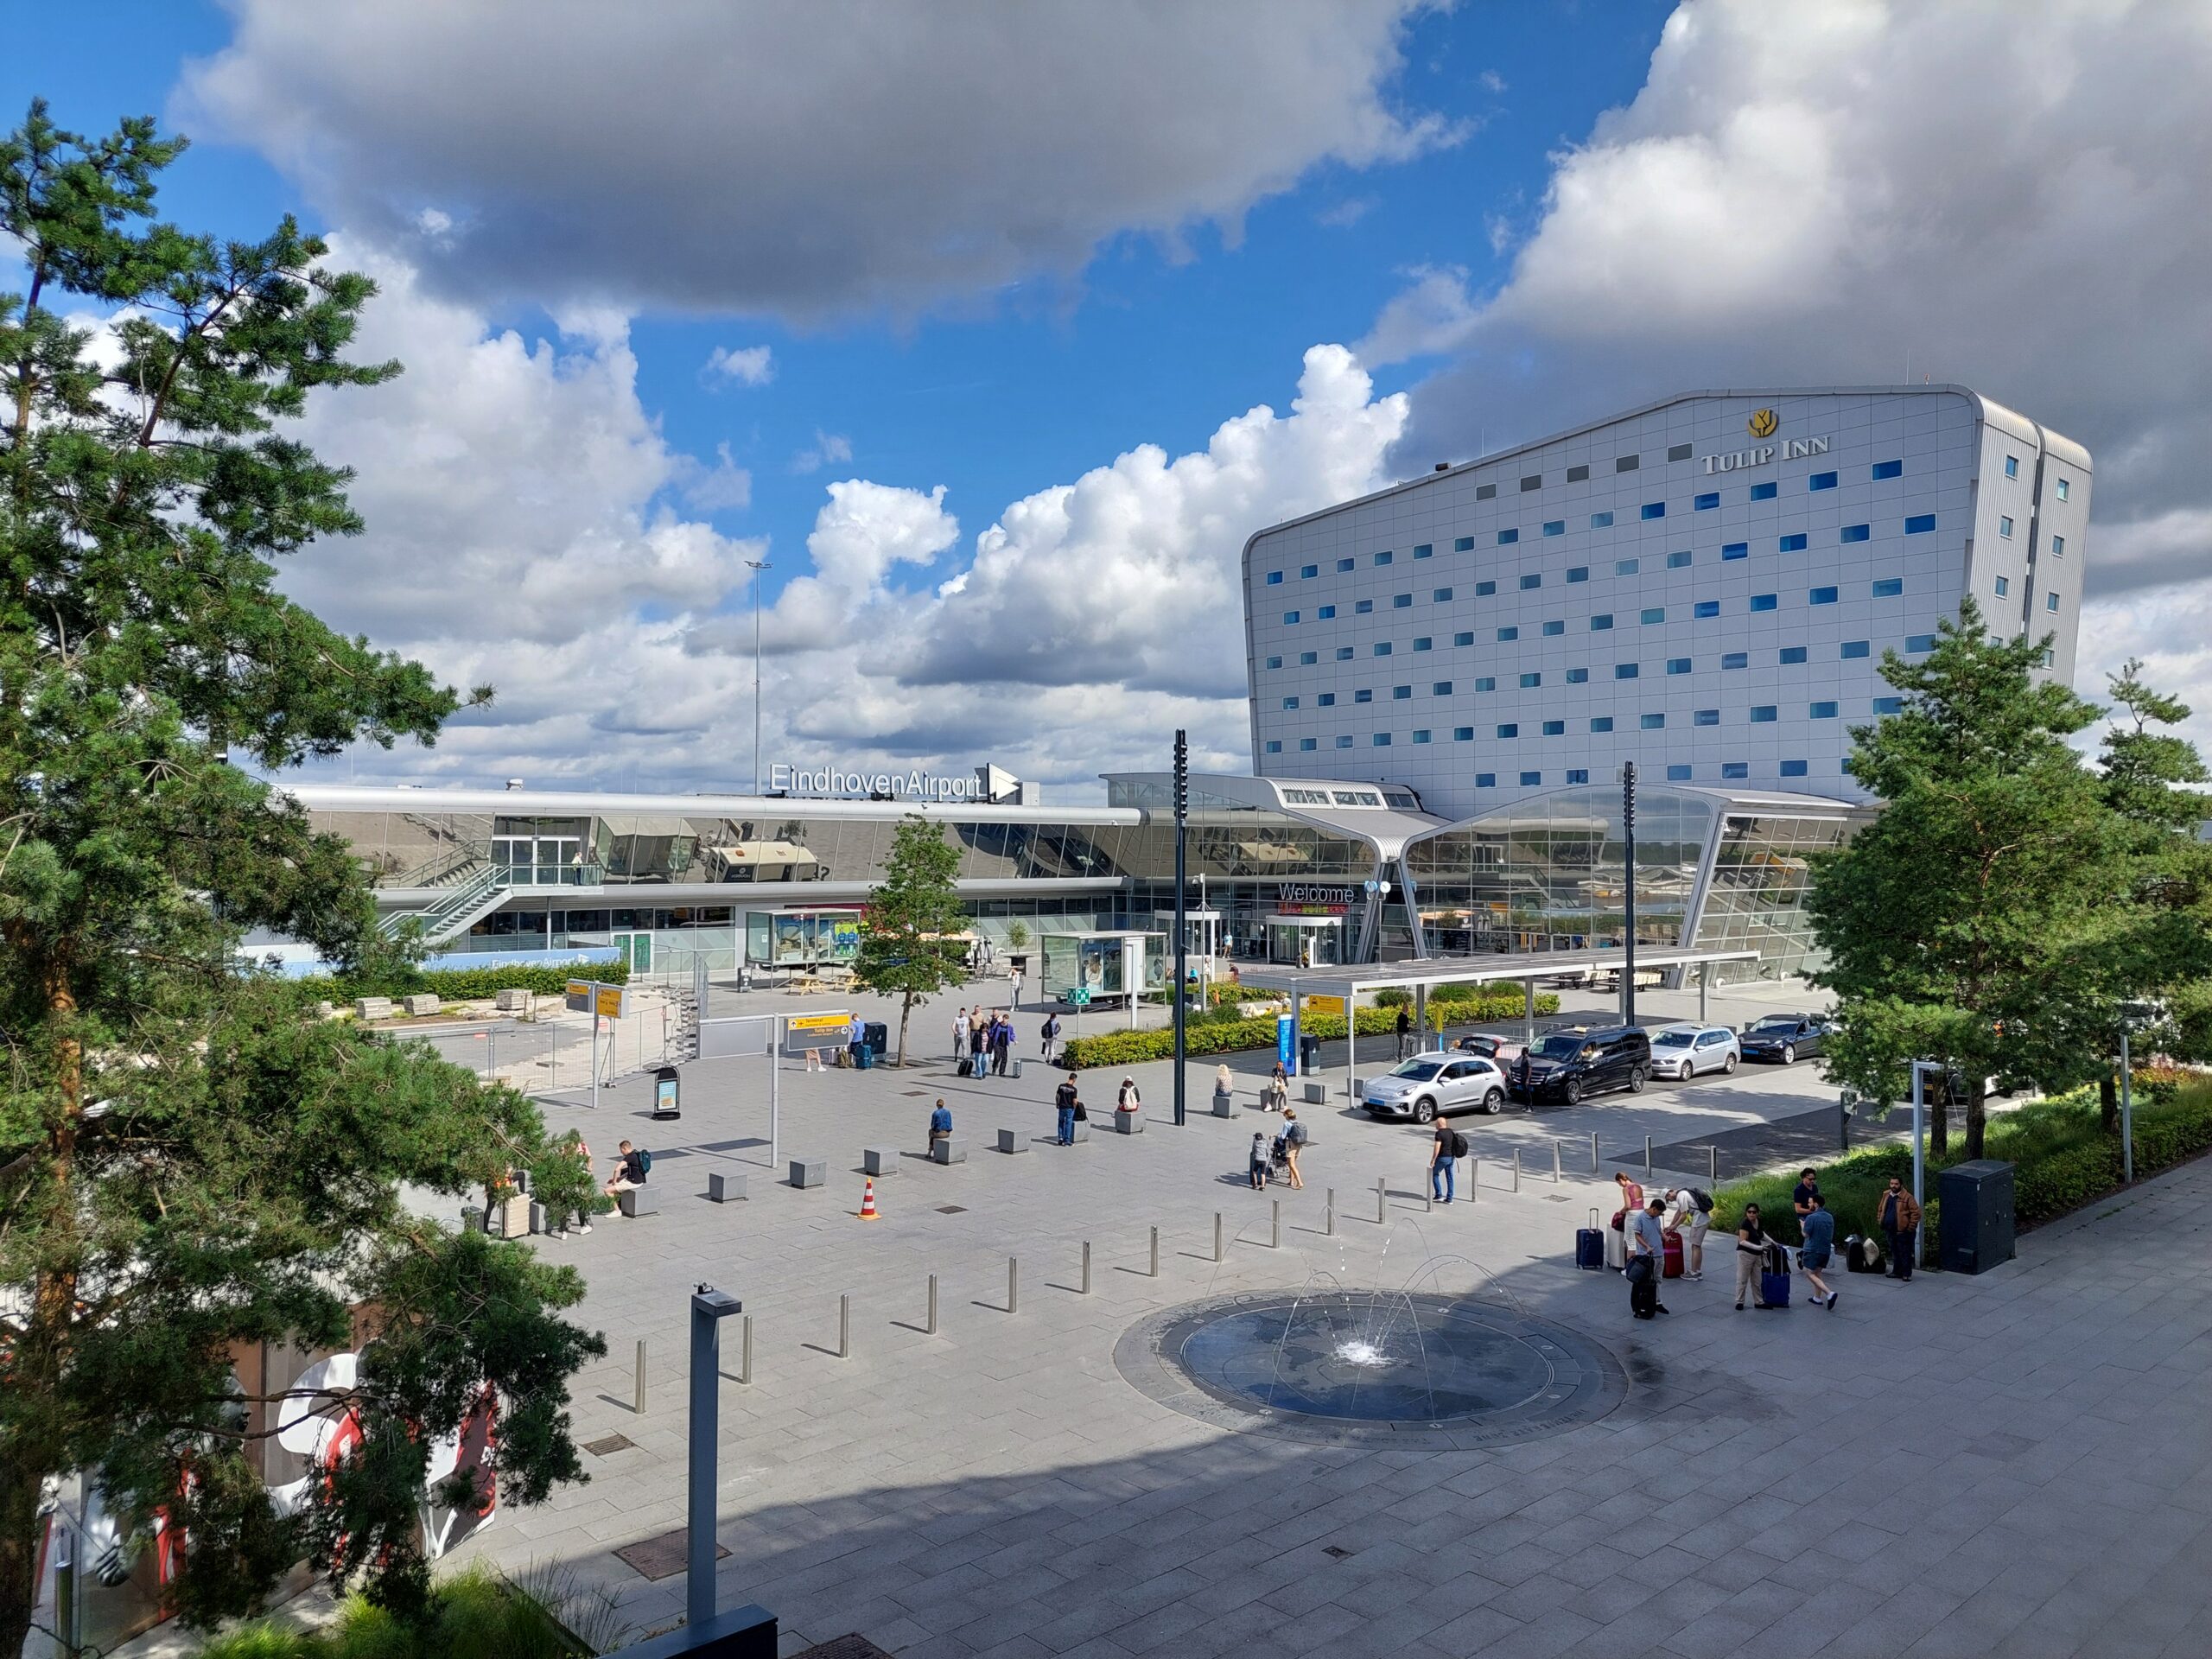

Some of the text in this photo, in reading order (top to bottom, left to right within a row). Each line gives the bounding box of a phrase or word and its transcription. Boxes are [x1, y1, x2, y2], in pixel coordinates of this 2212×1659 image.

[1701, 435, 1830, 475] TULIP INN
[769, 762, 982, 803] EindhovenAirport
[1279, 882, 1355, 903] Welcome
